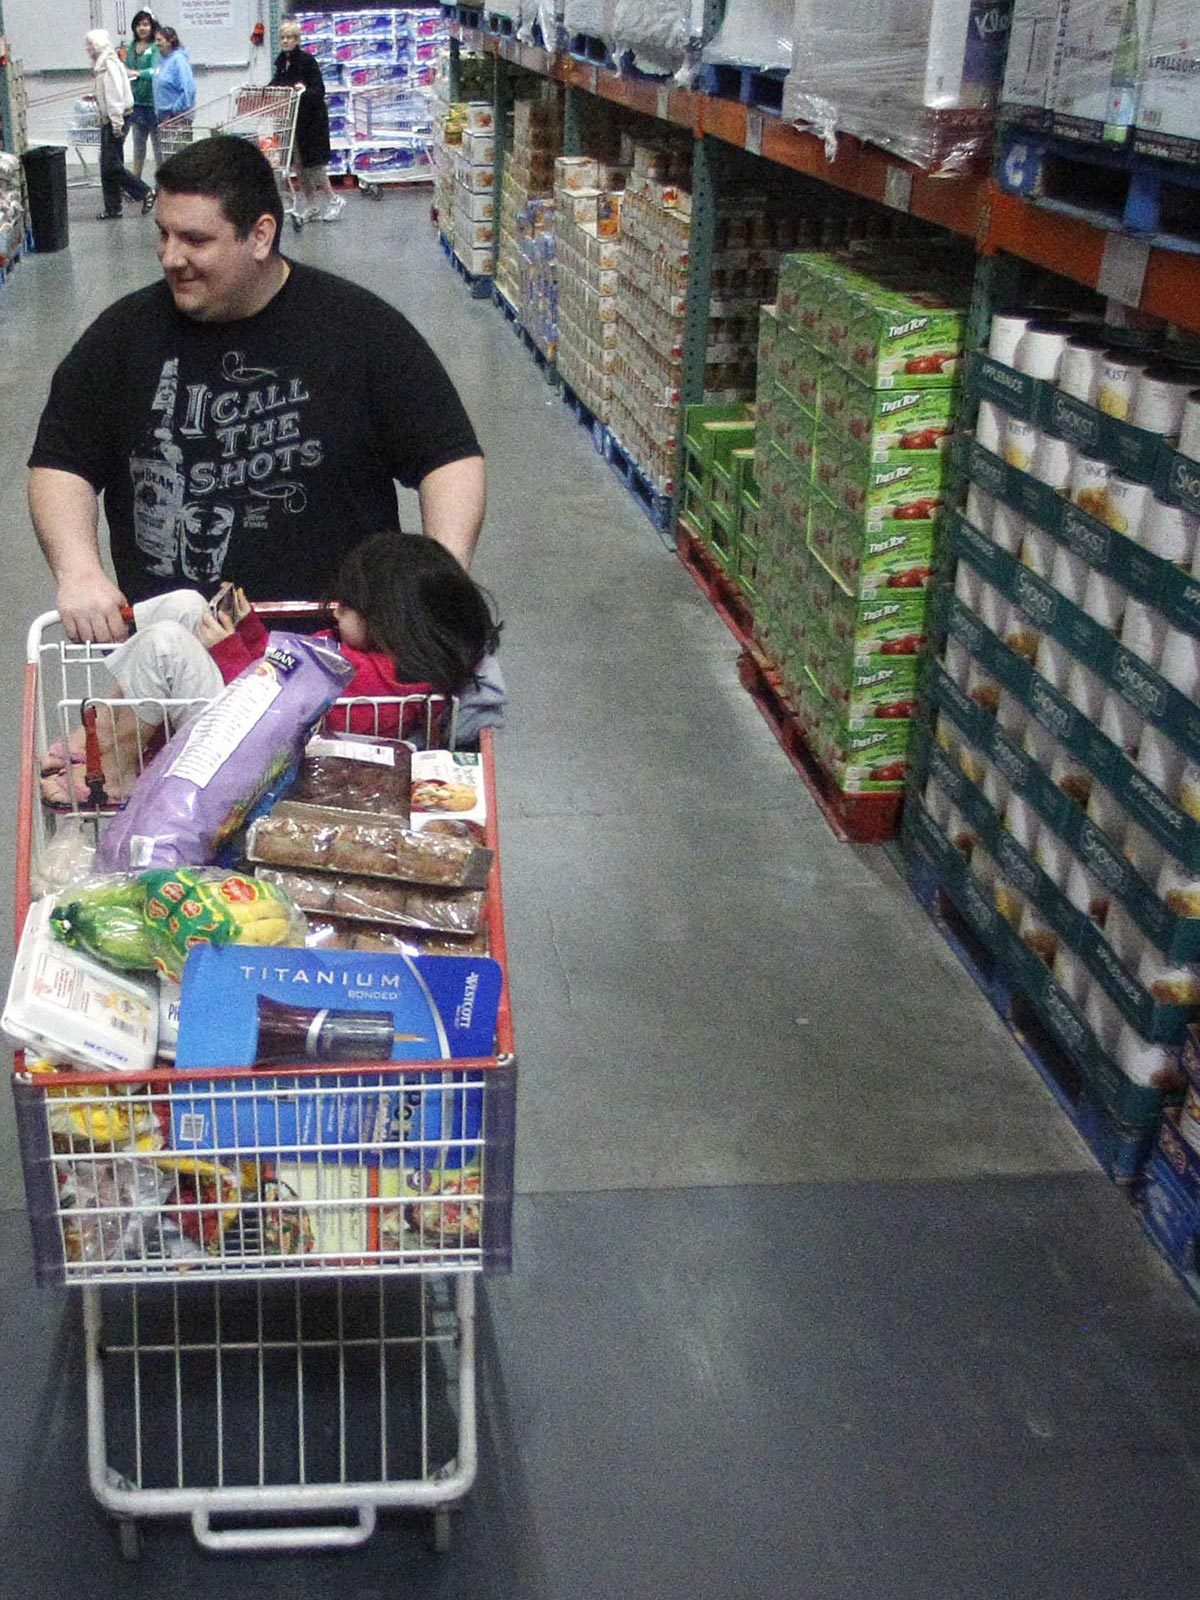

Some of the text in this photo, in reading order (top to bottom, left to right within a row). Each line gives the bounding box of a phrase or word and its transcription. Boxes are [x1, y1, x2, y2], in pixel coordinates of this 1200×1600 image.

[180, 377, 310, 439] I CALL
[216, 411, 301, 458] THE
[189, 440, 324, 495] SHOTS
[240, 966, 401, 988] TITANIUM
[348, 990, 398, 1000] BONDED
[461, 972, 479, 1029] WESTCOTT
